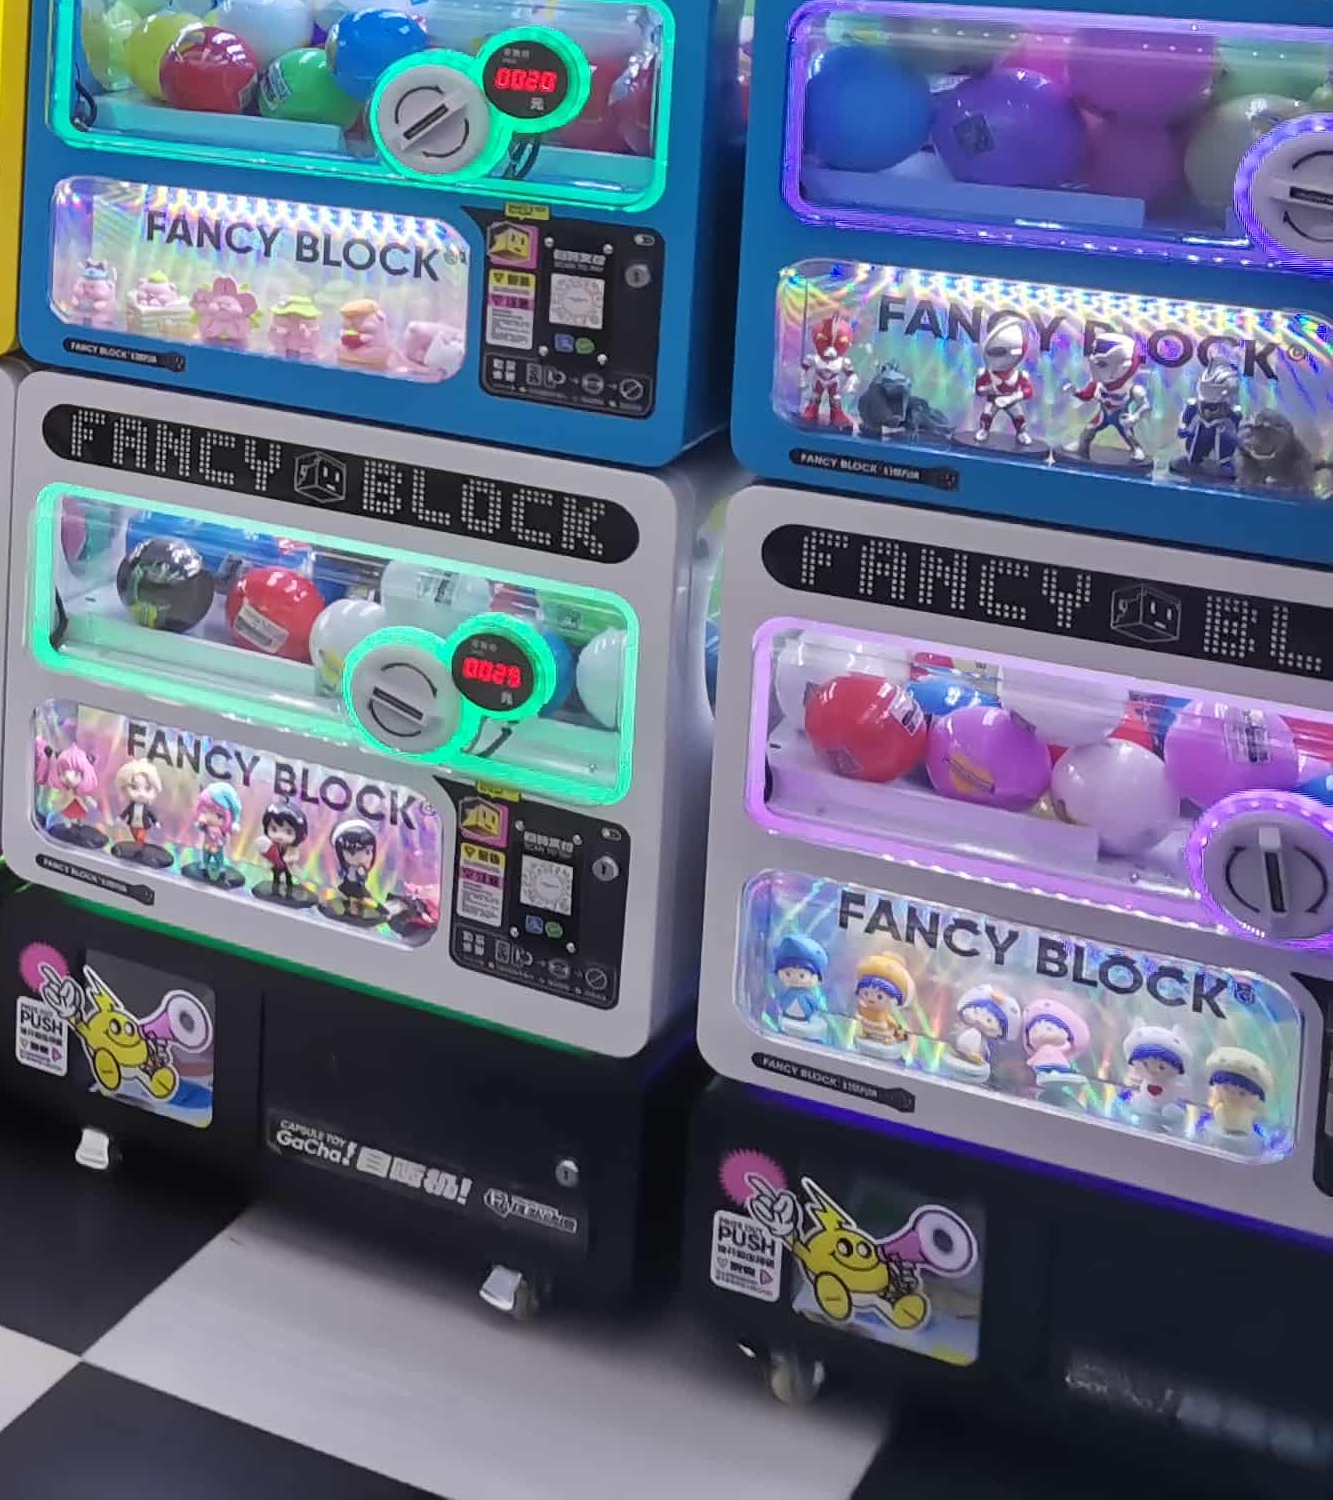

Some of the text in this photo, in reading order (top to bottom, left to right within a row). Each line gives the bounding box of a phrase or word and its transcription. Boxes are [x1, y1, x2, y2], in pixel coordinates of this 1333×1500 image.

[145, 210, 441, 282] FANCY BLOCK
[71, 412, 604, 555] FANCY BLOCK
[800, 452, 878, 474] FANCY BLOCK
[802, 530, 1091, 628] FANCY
[126, 723, 417, 830] FANCY BLOCK
[837, 888, 1230, 1019] FANCY BLOCK
[20, 1010, 64, 1037] PUSH
[762, 1057, 840, 1085] FANCY BLOCK
[279, 1119, 347, 1148] CAPSULE TOY
[717, 1224, 776, 1257] PUSH
